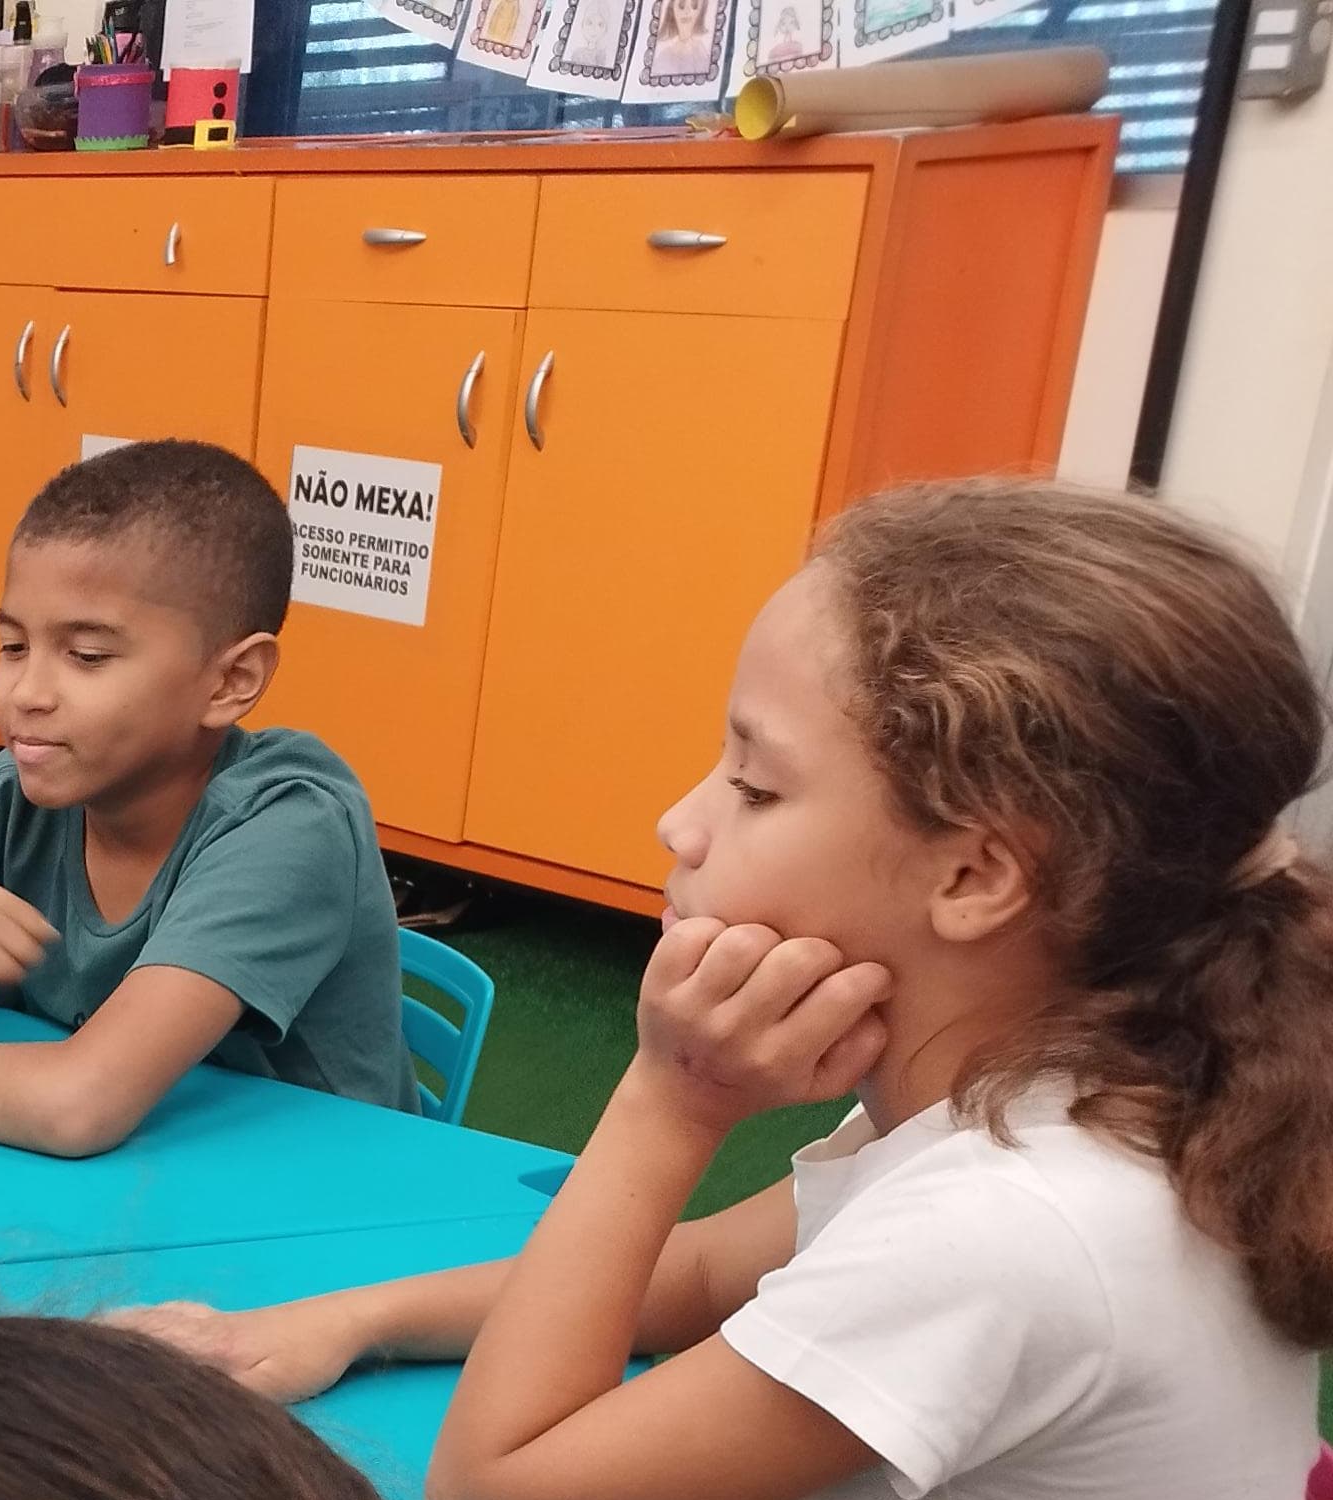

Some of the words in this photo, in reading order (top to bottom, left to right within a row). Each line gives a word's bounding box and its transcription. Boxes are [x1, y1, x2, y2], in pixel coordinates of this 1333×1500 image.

[294, 470, 348, 508] NÃO
[355, 483, 433, 522] MEXA!
[301, 543, 370, 569] SOMENTE
[373, 555, 411, 576] PARA
[348, 532, 430, 560] PERMITIDO
